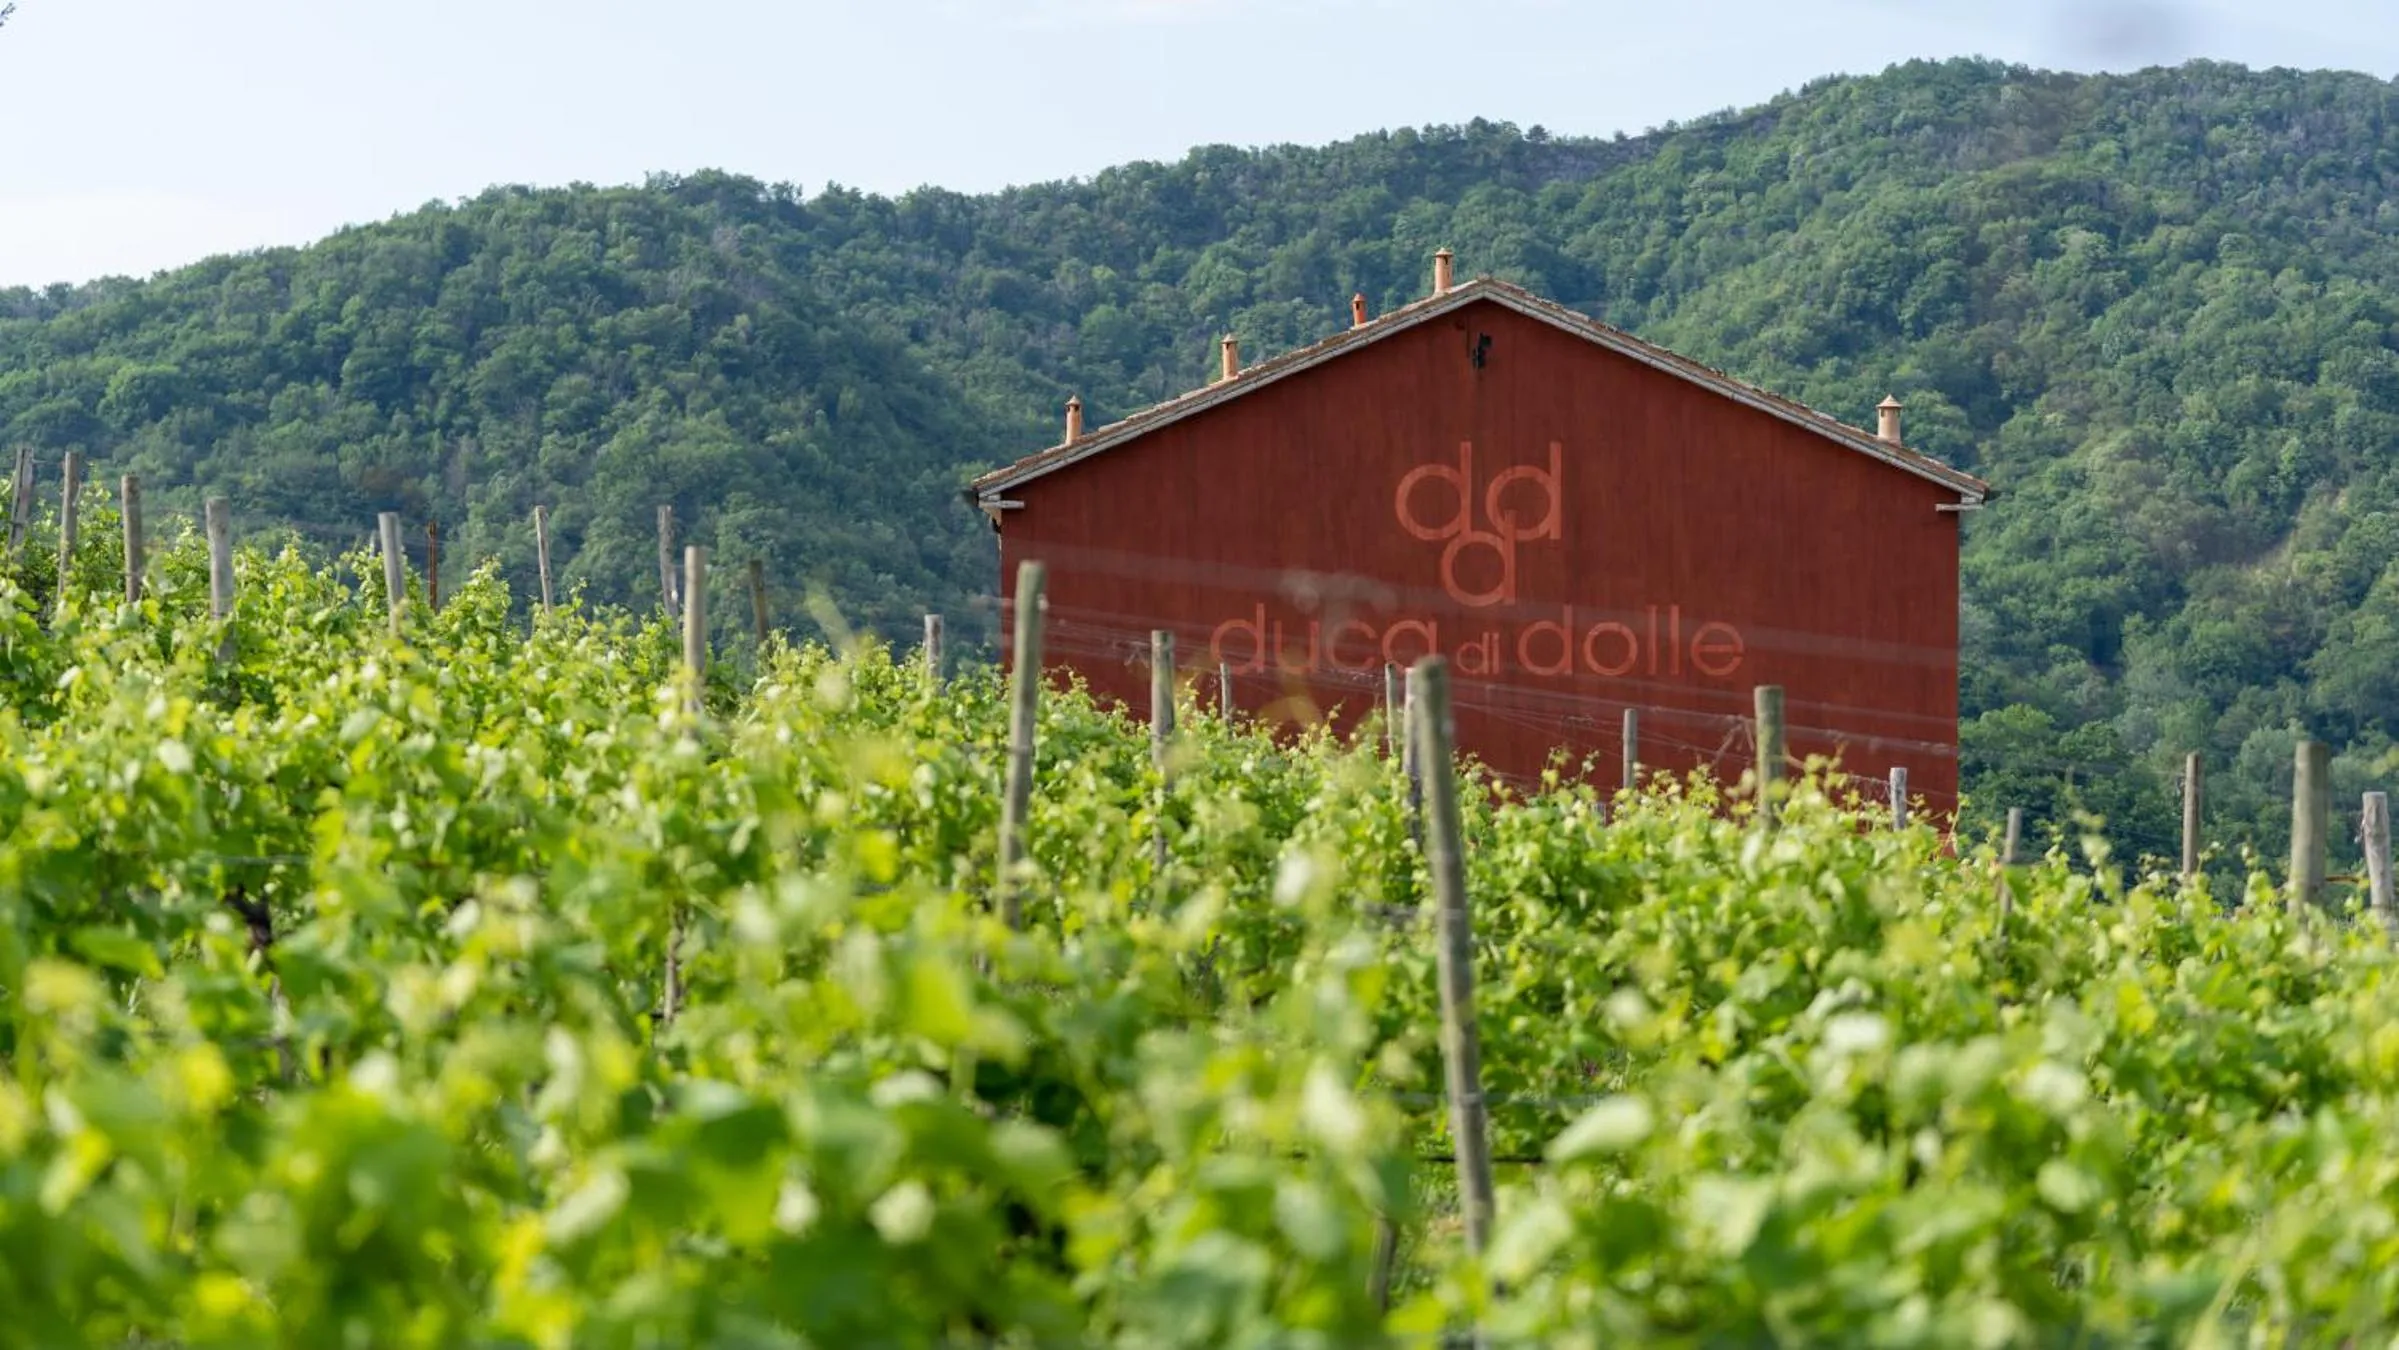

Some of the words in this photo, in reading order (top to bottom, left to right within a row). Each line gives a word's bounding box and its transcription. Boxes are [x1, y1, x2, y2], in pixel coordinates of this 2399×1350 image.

[1210, 602, 1438, 675] duca
[1455, 631, 1501, 676] di
[1517, 603, 1745, 677] dolle
